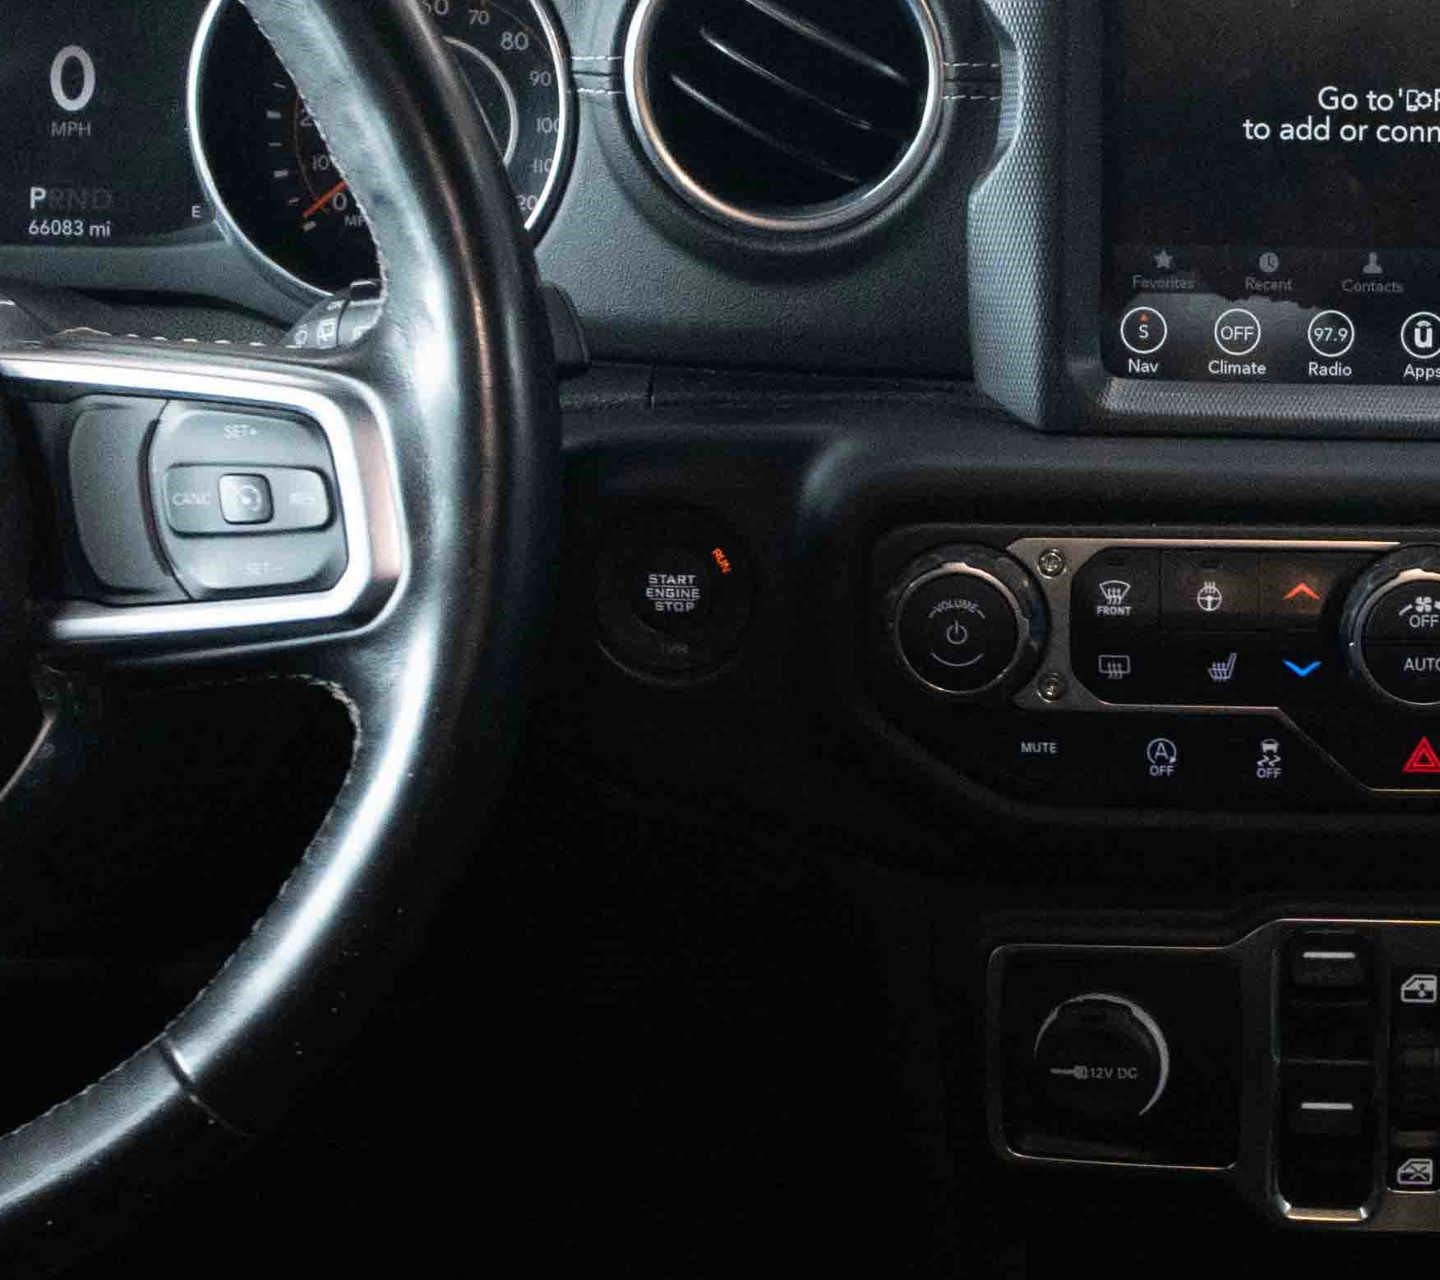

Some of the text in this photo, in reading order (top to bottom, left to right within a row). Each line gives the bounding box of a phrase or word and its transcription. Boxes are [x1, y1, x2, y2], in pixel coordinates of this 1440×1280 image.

[468, 9, 491, 26] 70
[500, 31, 530, 51] 80
[50, 46, 95, 111] 0
[529, 70, 552, 87] 90
[1318, 86, 1358, 110] Go
[1366, 91, 1394, 111] to
[52, 121, 91, 136] MPH
[1243, 119, 1270, 140] to
[1280, 115, 1330, 140] add
[1340, 125, 1368, 141] or
[333, 191, 348, 211] 0
[29, 220, 110, 236] 66083 mi
[1132, 274, 1196, 290] Favorites
[1244, 276, 1293, 292] Recent
[1341, 278, 1404, 294] Contacts
[1220, 325, 1255, 342] OFF
[1313, 327, 1348, 343] 97.9
[1128, 358, 1158, 373] Nav
[1208, 360, 1266, 374] Climate
[1309, 362, 1352, 376] Radio
[648, 573, 697, 586] START
[645, 587, 702, 601] ENGINE
[654, 600, 697, 614] STOP
[934, 600, 979, 615] VOLUME
[1096, 605, 1132, 616] FRONT
[1409, 614, 1439, 628] OFF
[1021, 742, 1056, 753] MUTE
[1149, 765, 1175, 777] OFF
[1256, 767, 1282, 779] OFF
[1117, 1067, 1137, 1079] DC
